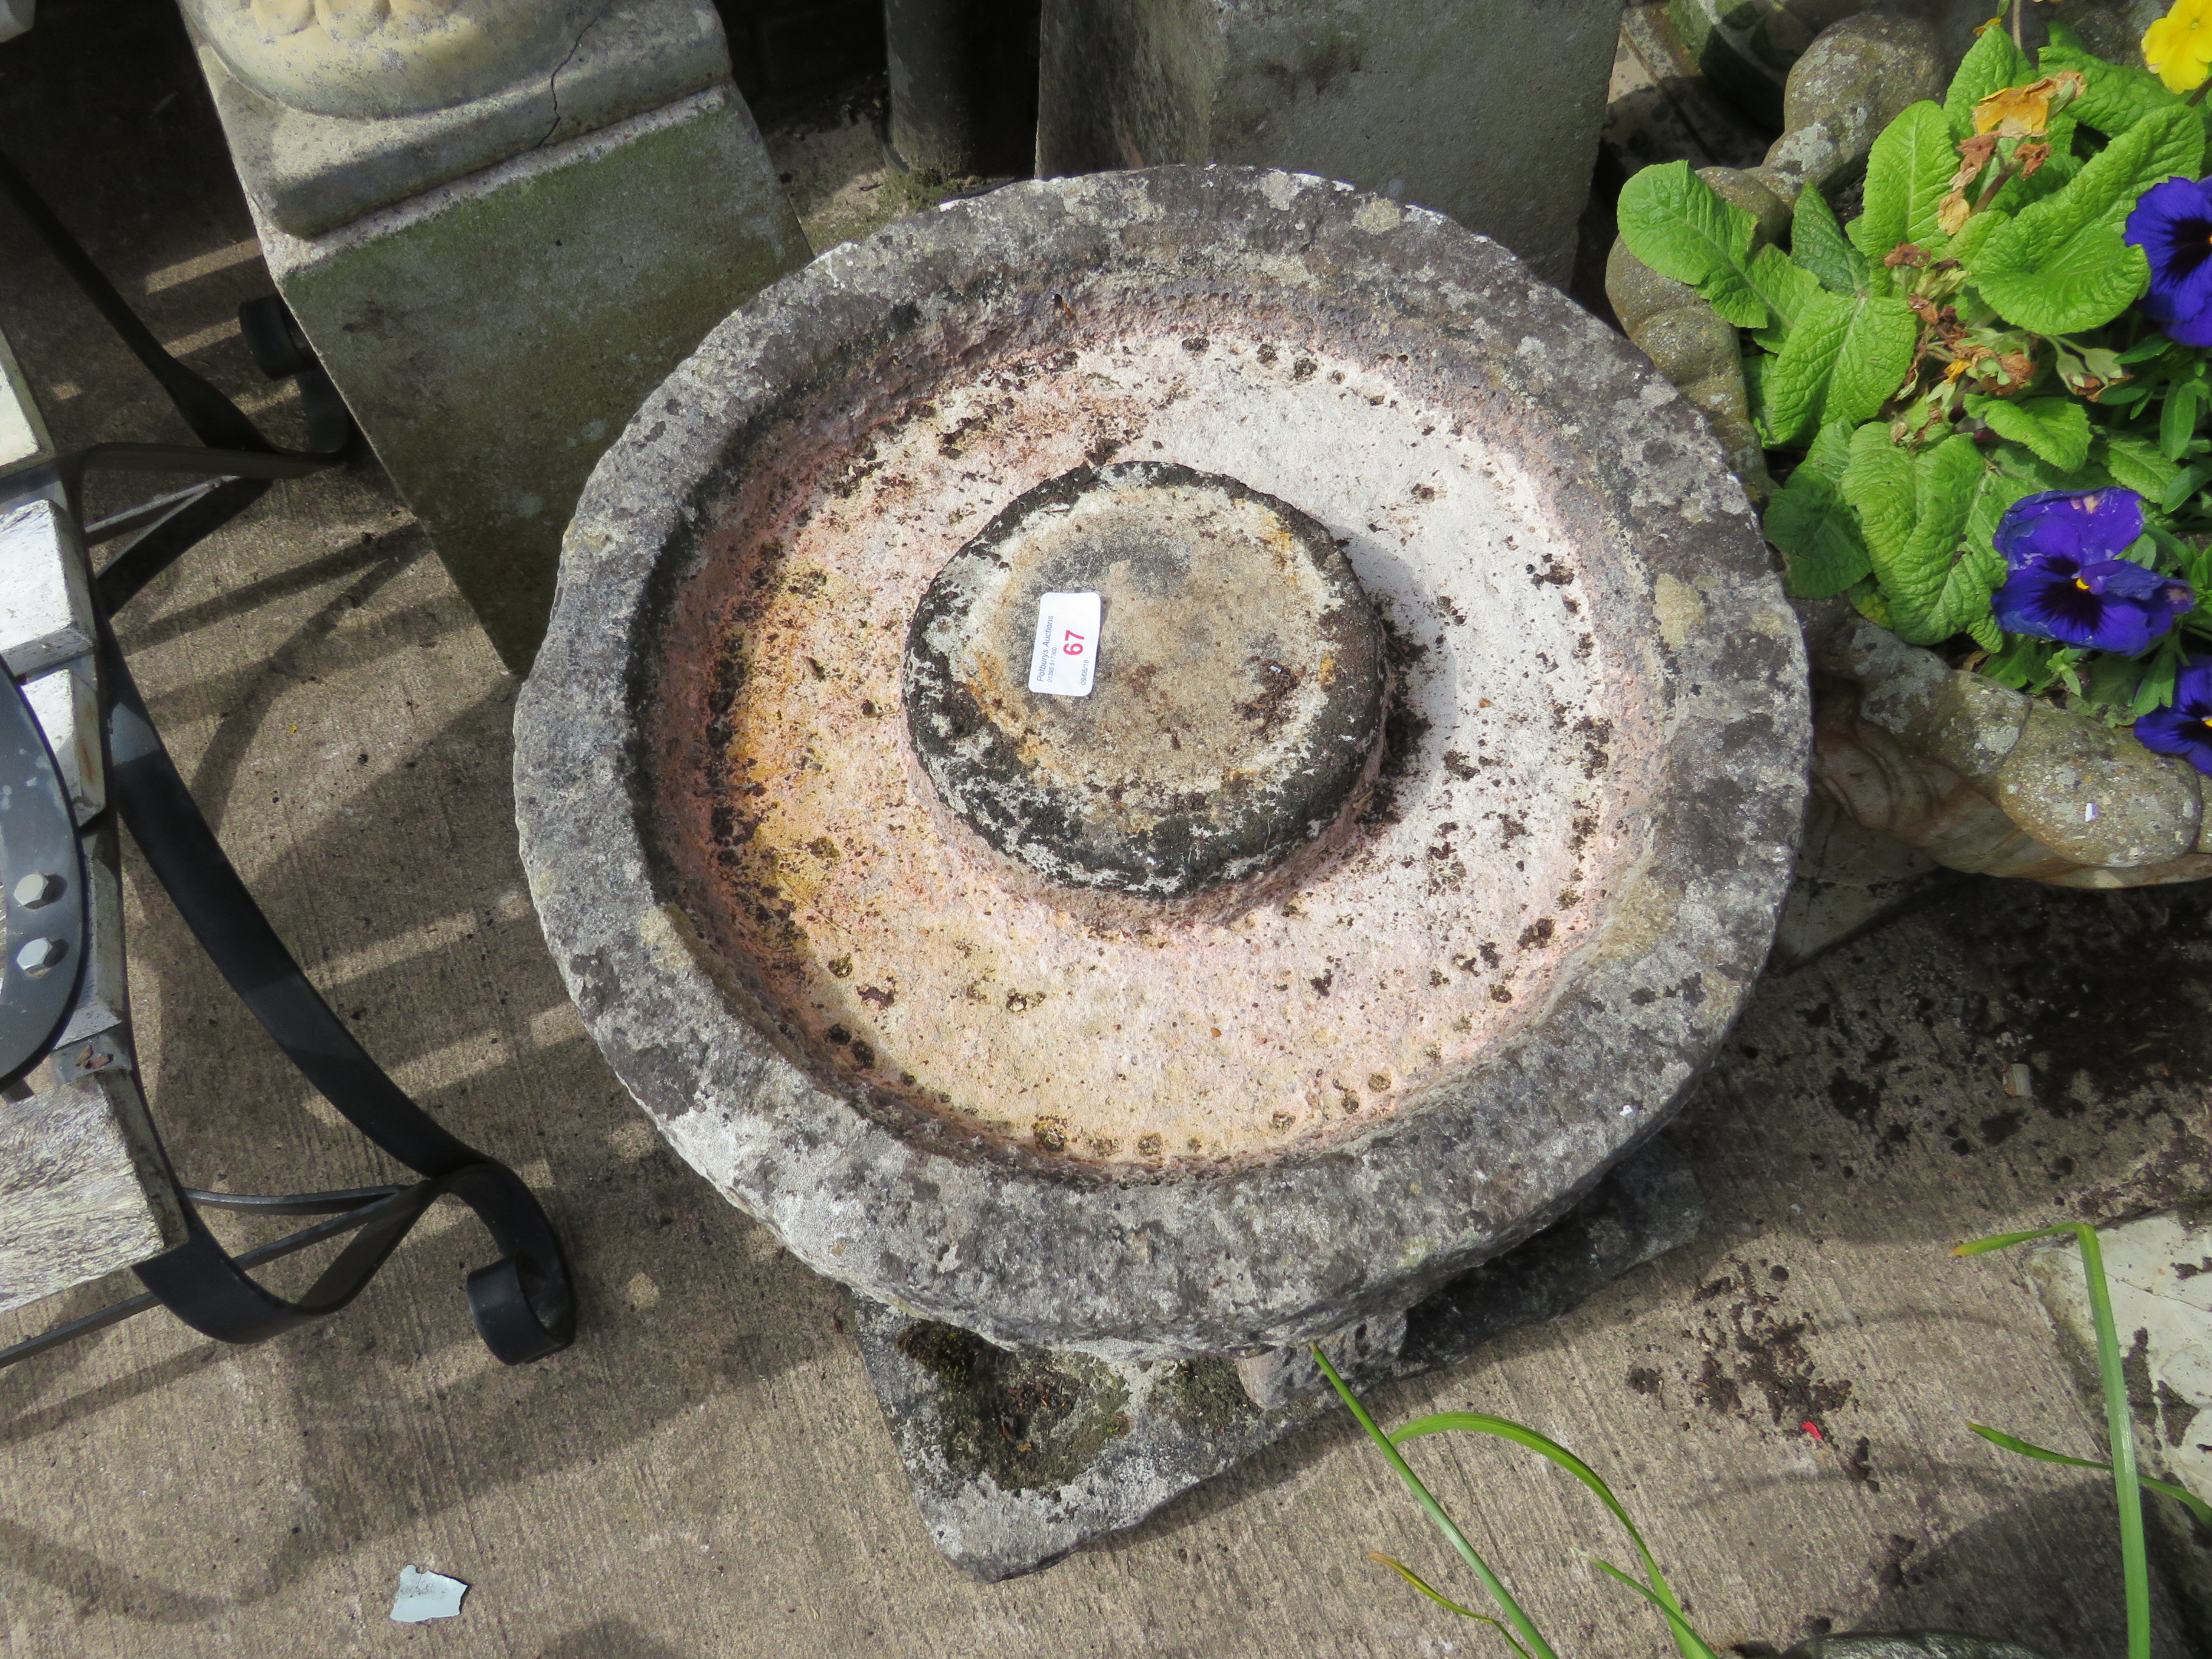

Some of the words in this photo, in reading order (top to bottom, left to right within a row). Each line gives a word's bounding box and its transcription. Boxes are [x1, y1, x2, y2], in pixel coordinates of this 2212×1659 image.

[1042, 615, 1054, 648] Auctions
[1063, 630, 1085, 655] 67
[1037, 649, 1050, 682] Potburys
[1049, 646, 1057, 666] 517300
[1081, 659, 1090, 685] 09/05/18
